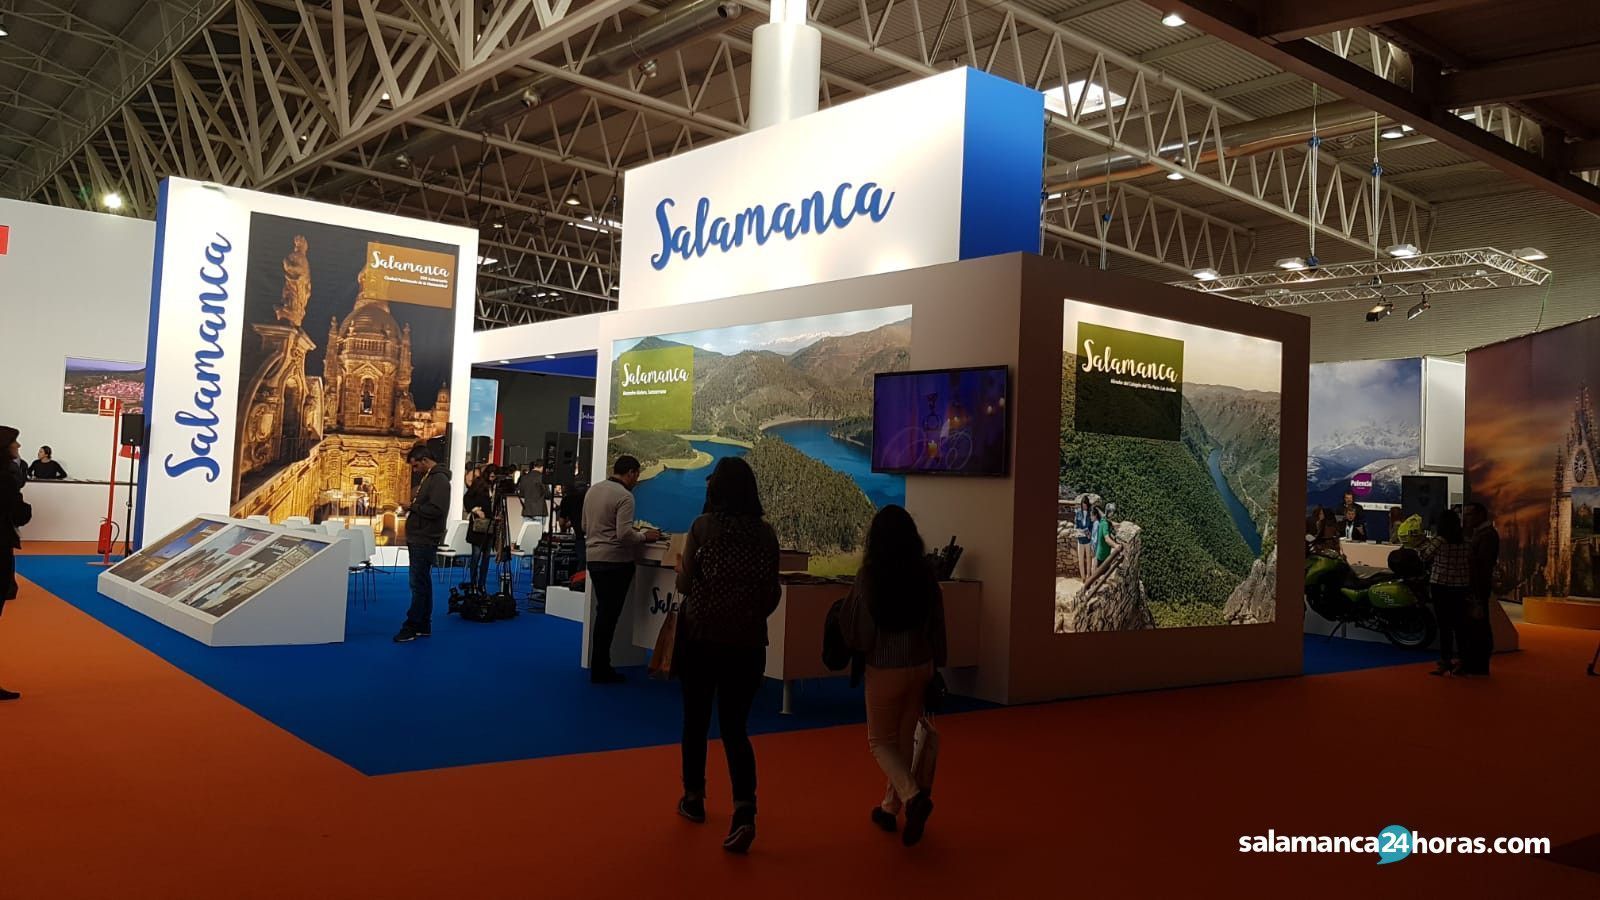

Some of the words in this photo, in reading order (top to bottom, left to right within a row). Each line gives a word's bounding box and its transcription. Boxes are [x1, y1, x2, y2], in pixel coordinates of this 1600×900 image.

[650, 182, 895, 271] Salamanca
[371, 250, 450, 278] Salamanca
[164, 232, 232, 483] Salamanca
[621, 362, 689, 387] Salamanca
[1081, 339, 1178, 383] Salamanca
